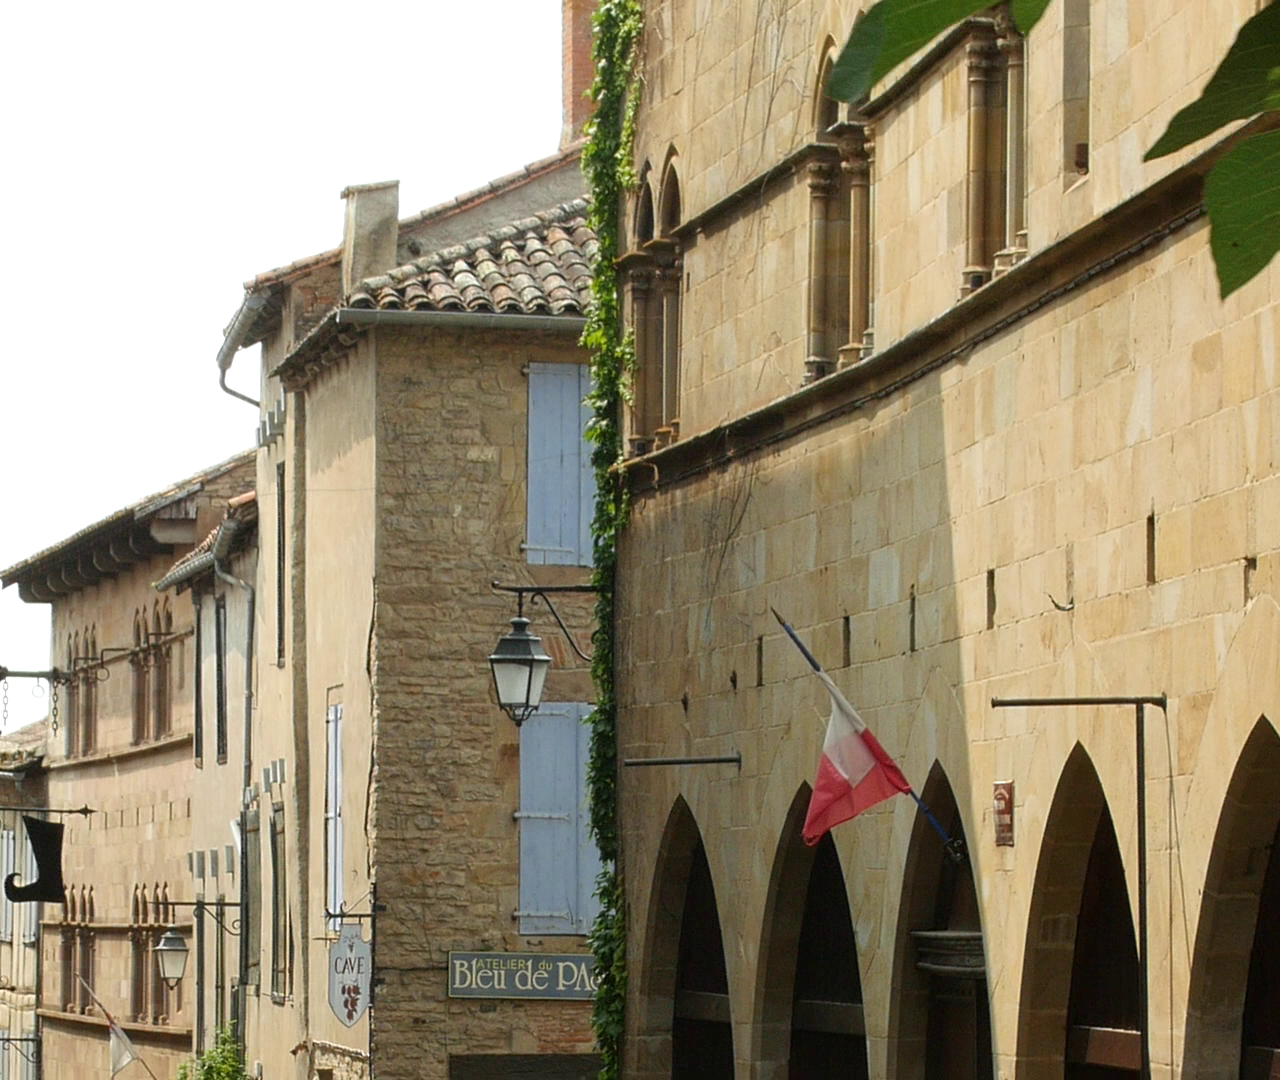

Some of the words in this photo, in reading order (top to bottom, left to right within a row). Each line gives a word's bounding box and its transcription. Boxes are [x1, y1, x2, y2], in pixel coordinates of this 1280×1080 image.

[334, 956, 365, 975] CAVE
[453, 957, 507, 989] Bleu
[515, 959, 549, 990] de
[476, 958, 526, 970] ATELIER
[538, 959, 553, 971] du
